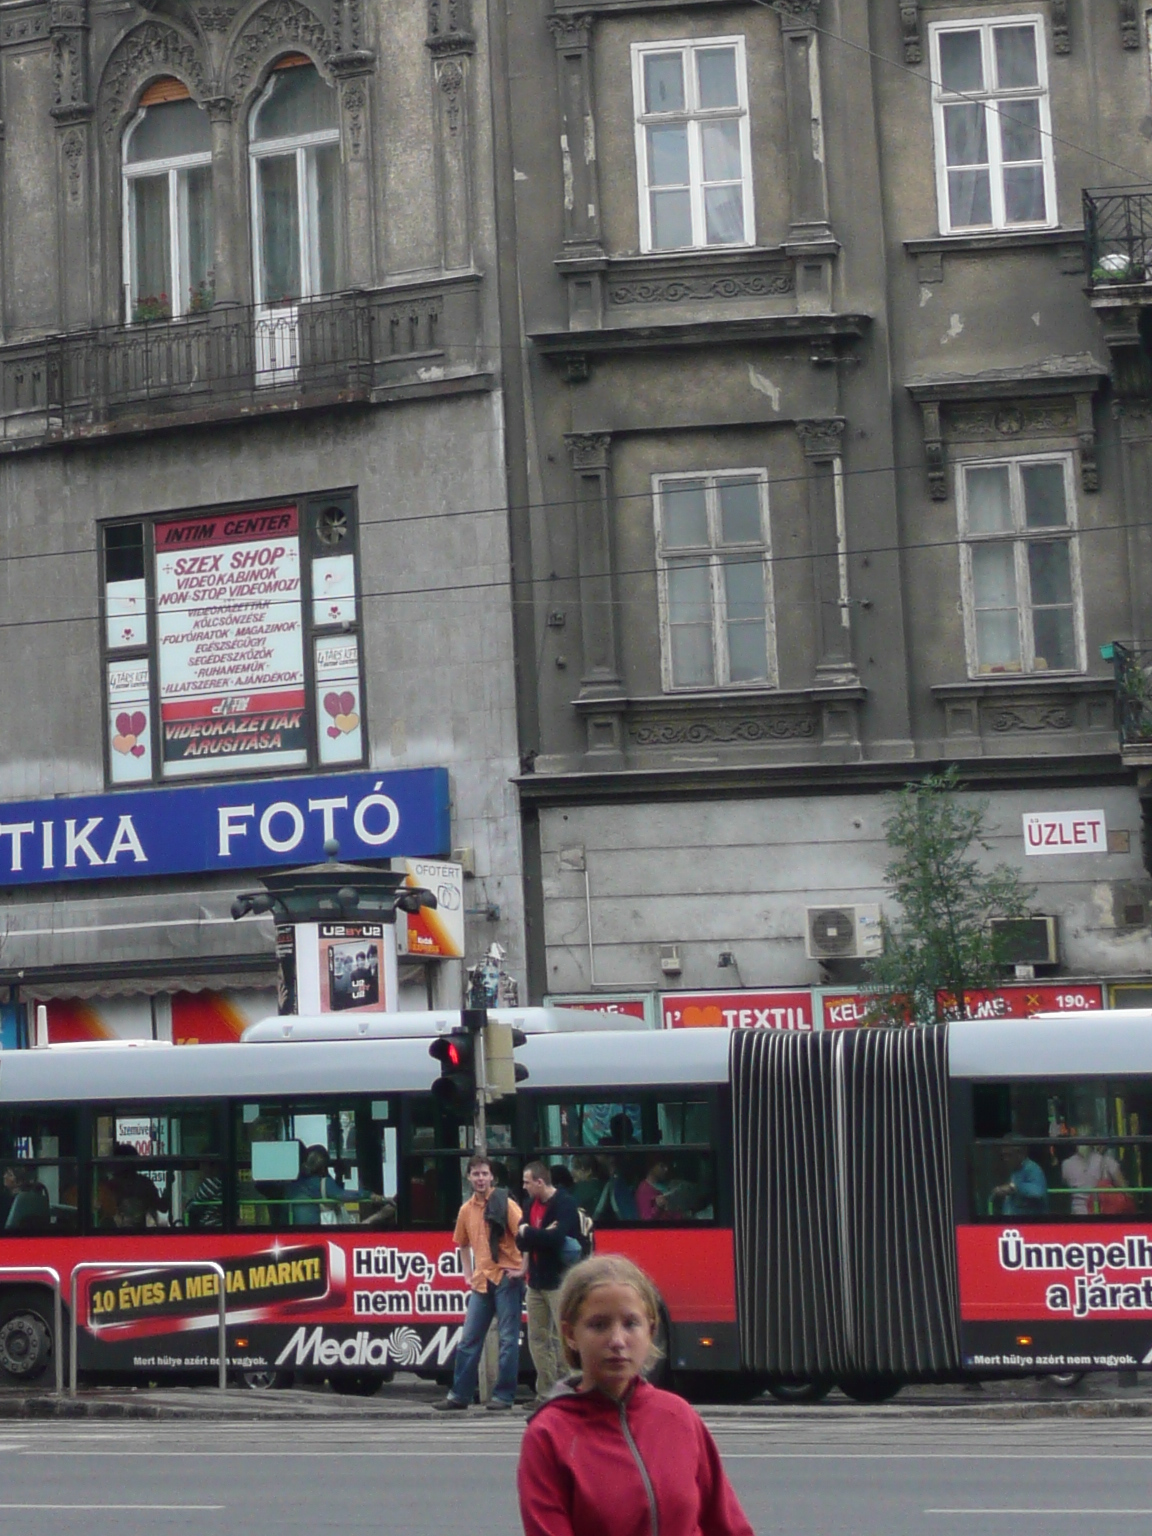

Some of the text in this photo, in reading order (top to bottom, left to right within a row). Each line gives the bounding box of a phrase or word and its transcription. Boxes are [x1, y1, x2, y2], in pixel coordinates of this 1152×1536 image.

[165, 514, 291, 543] INTIM CENTER
[174, 547, 286, 576] SZEX SHOP
[176, 567, 280, 590] VIDEOKABINOK
[165, 711, 303, 741] VIDEOKAZETTÁK
[217, 781, 400, 856] FOTÓ
[1027, 818, 1100, 846] ÜZLET
[722, 1008, 811, 1030] TEXTIL
[355, 1248, 434, 1281] Hülye,
[92, 1290, 115, 1314] 10
[119, 1280, 165, 1309] ÉVES
[168, 1279, 182, 1302] A
[249, 1258, 321, 1289] MARKT!
[1047, 1284, 1070, 1309] a
[355, 1290, 412, 1314] nem
[974, 1355, 1000, 1364] Mert
[1066, 1356, 1092, 1364] nem
